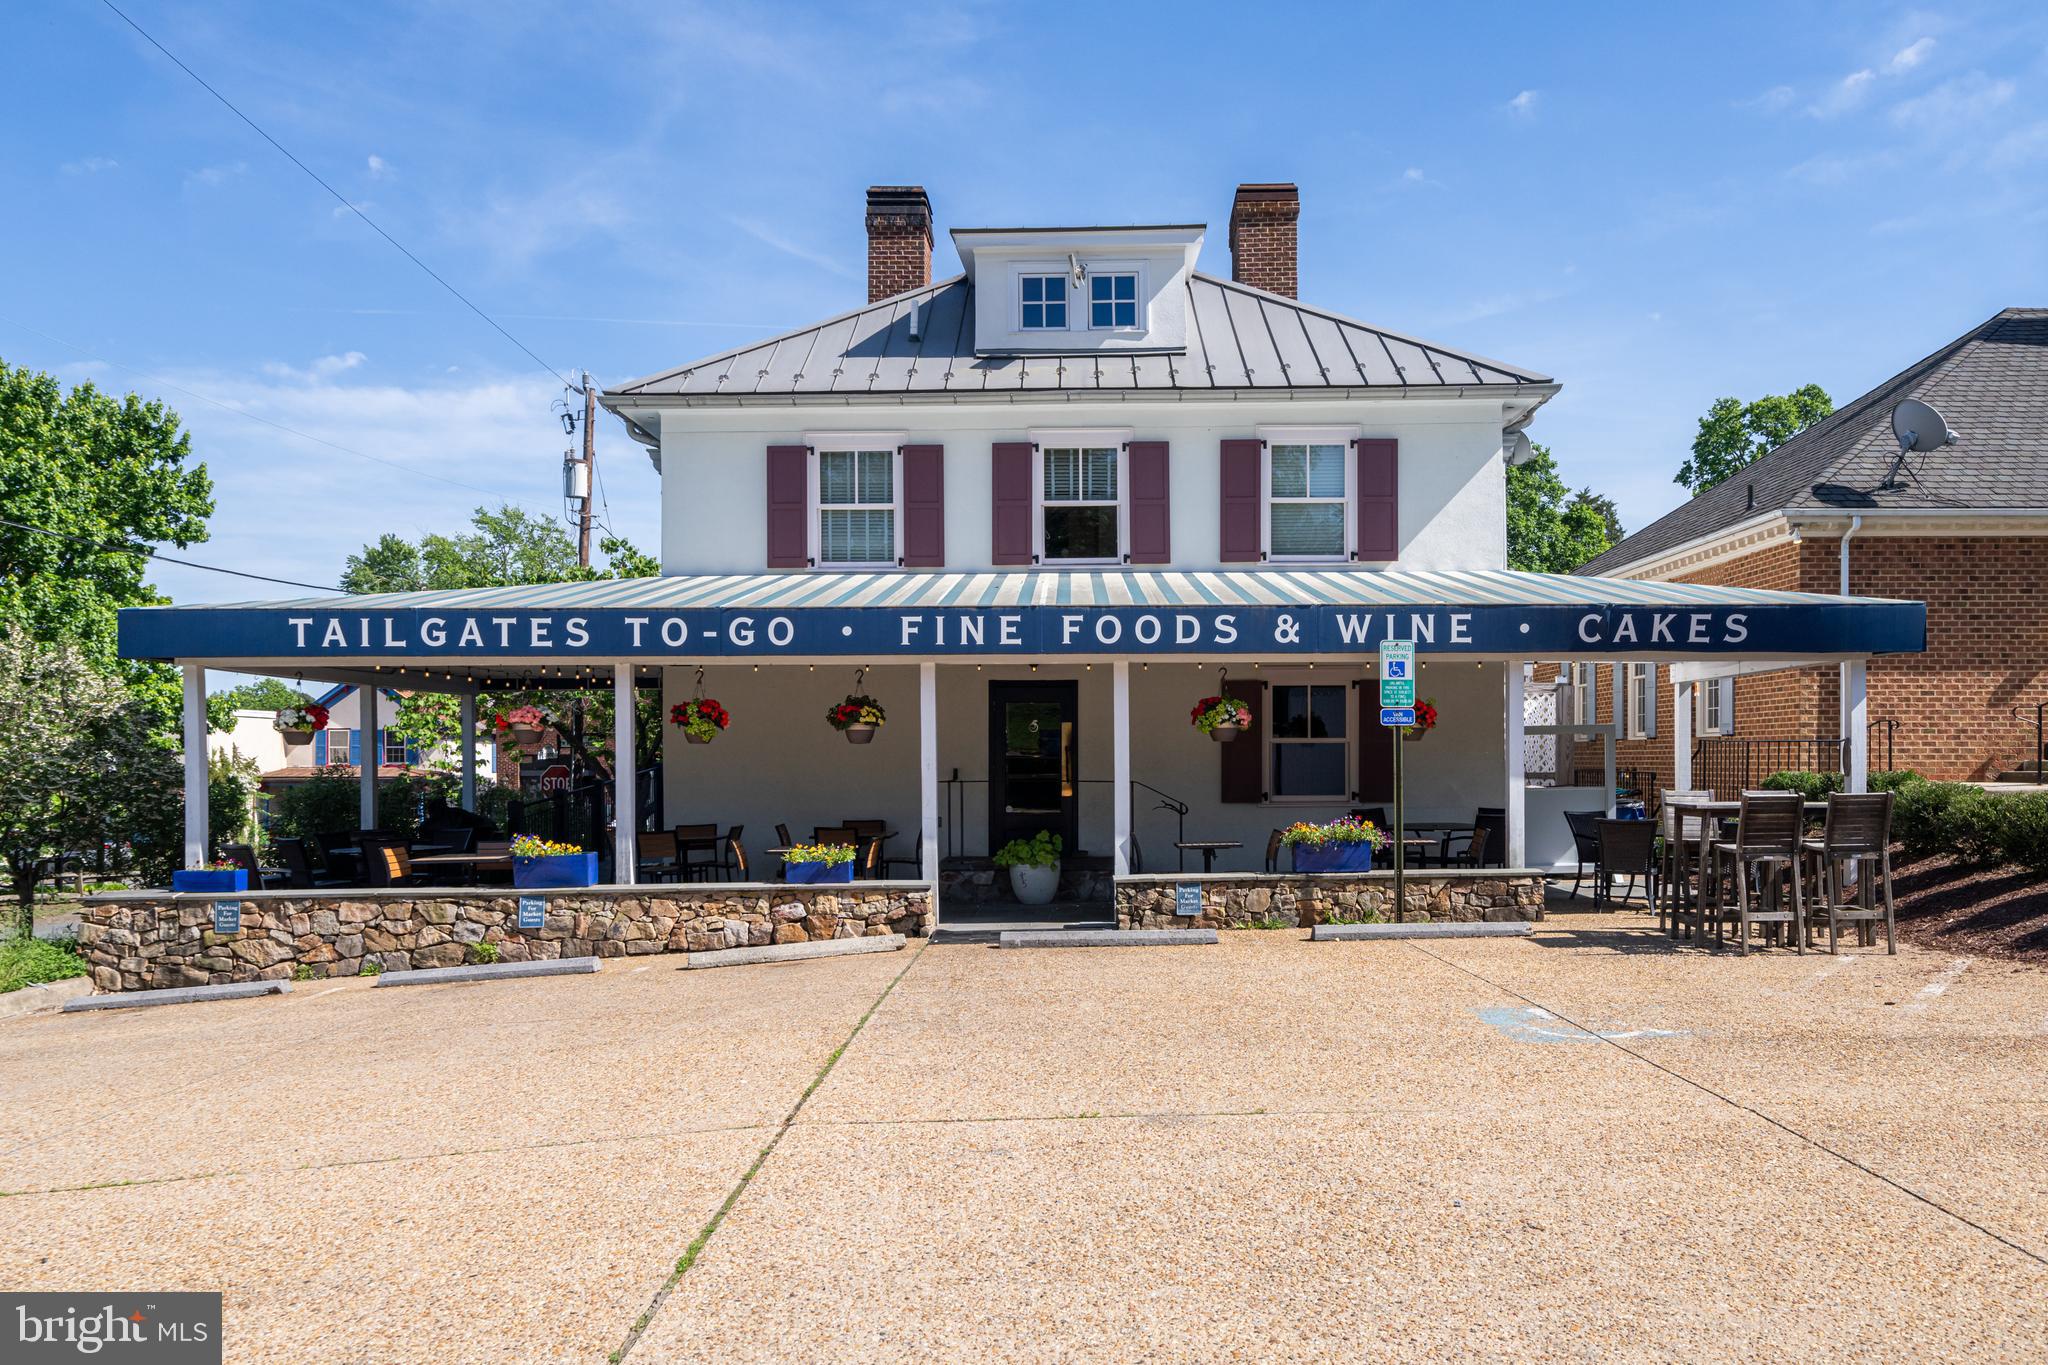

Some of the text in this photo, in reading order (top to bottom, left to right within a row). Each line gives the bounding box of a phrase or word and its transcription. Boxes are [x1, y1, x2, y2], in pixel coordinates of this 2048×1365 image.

[288, 613, 1747, 648] TAILGATES TO-GO FINE FOODS & WINE CAKES
